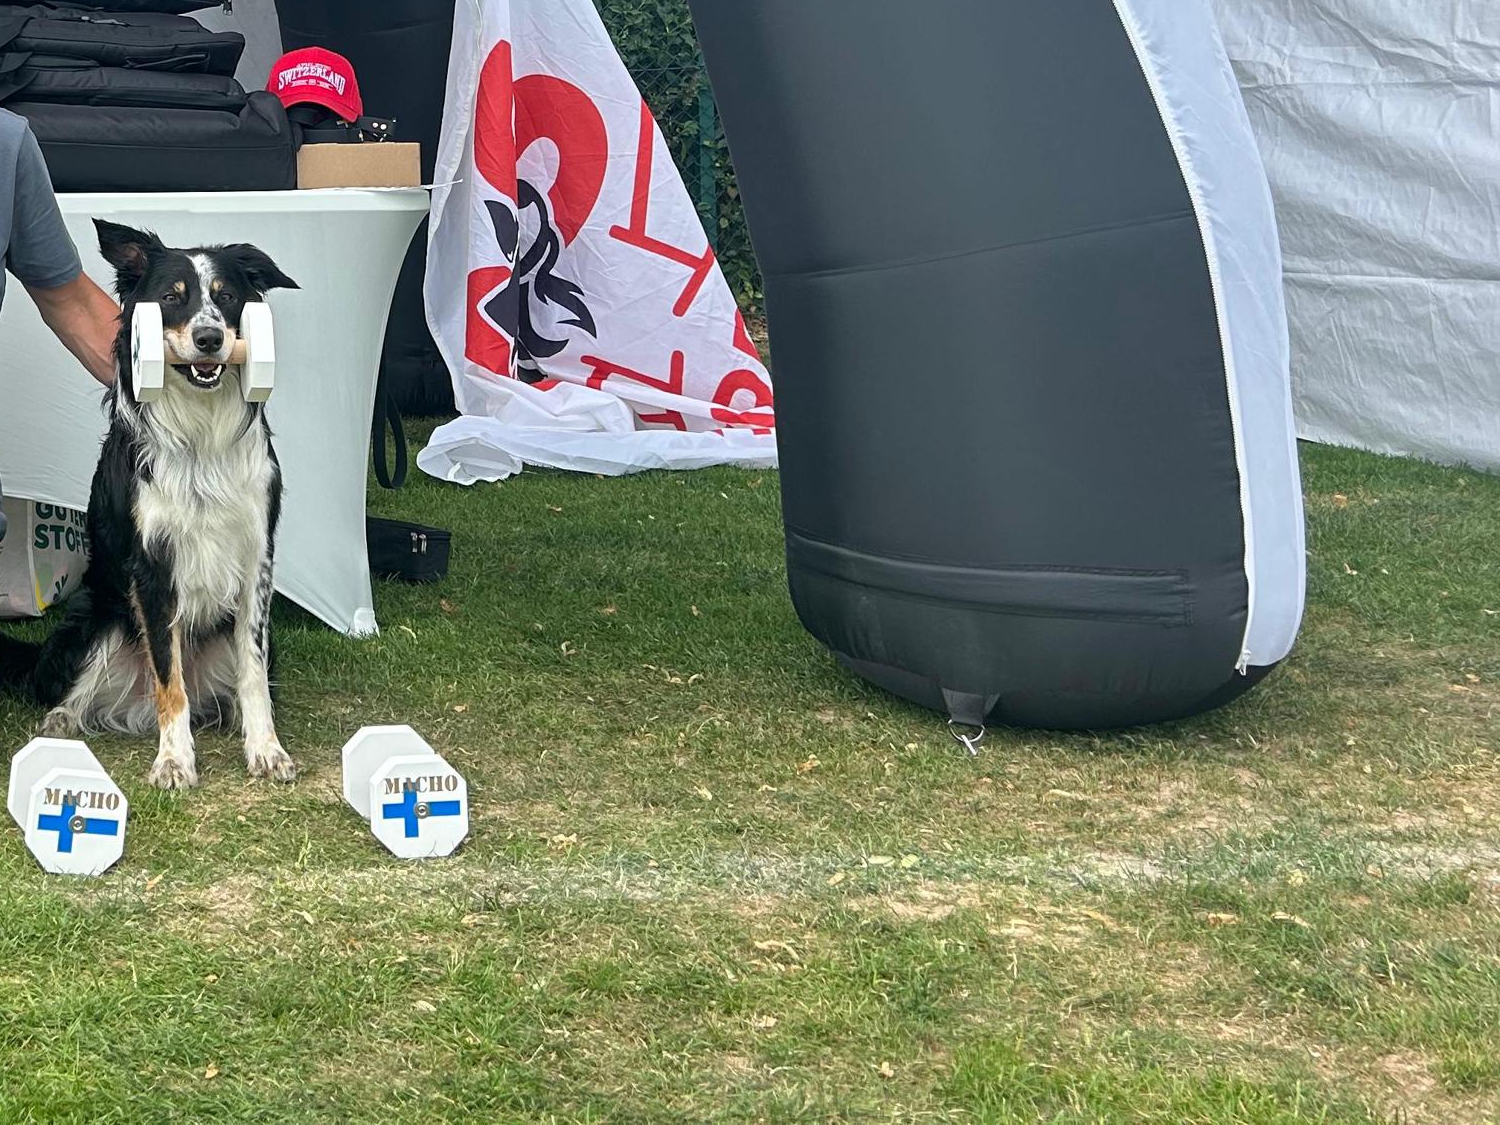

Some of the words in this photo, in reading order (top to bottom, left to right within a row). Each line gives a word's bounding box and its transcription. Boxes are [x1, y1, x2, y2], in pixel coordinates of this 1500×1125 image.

[278, 66, 347, 96] SWITZERLAND
[383, 775, 458, 794] MACHO
[44, 787, 120, 810] MACHO
